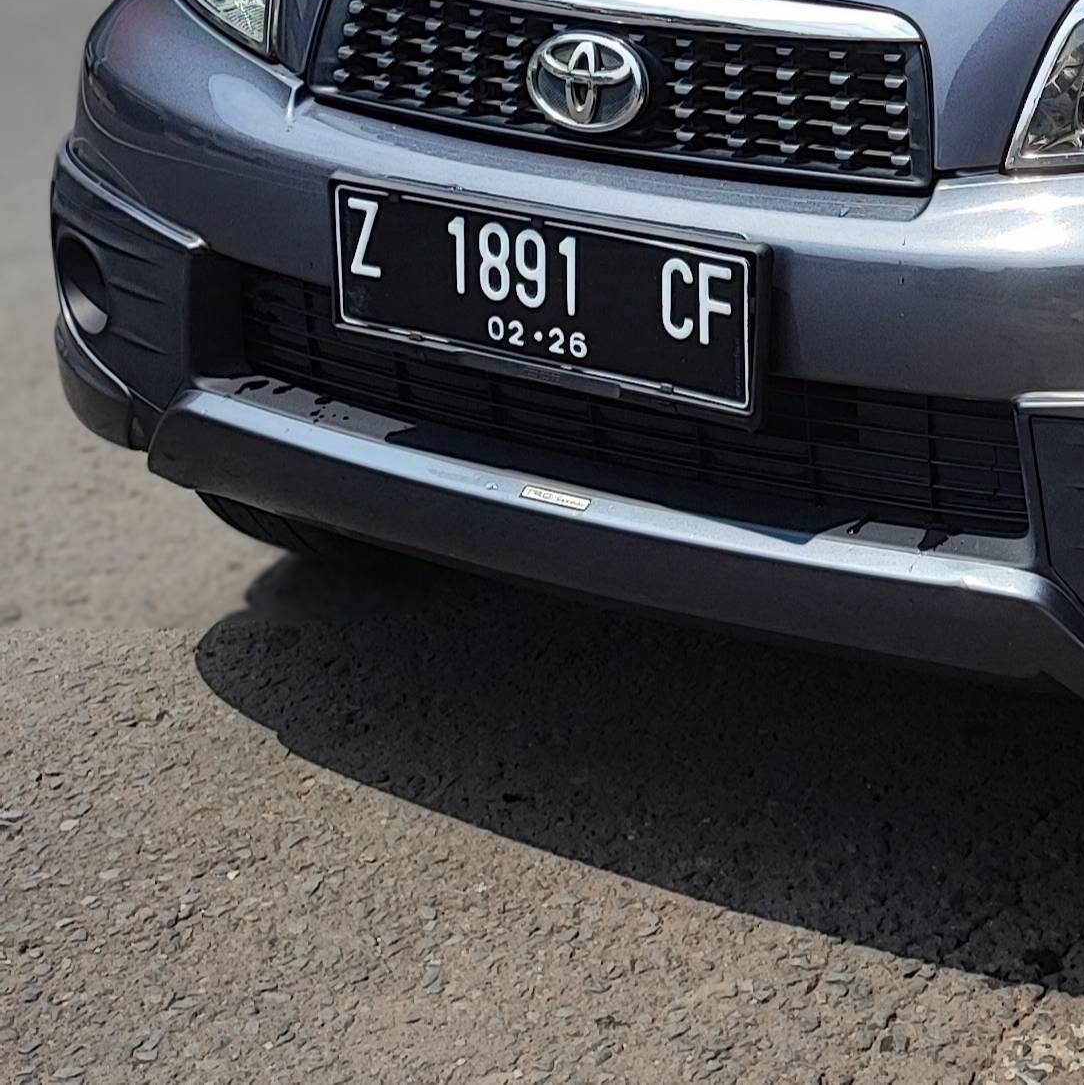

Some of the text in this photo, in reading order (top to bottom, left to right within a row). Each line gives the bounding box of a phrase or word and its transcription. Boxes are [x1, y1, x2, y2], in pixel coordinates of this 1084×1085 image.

[347, 197, 732, 345] Z 1891 CF
